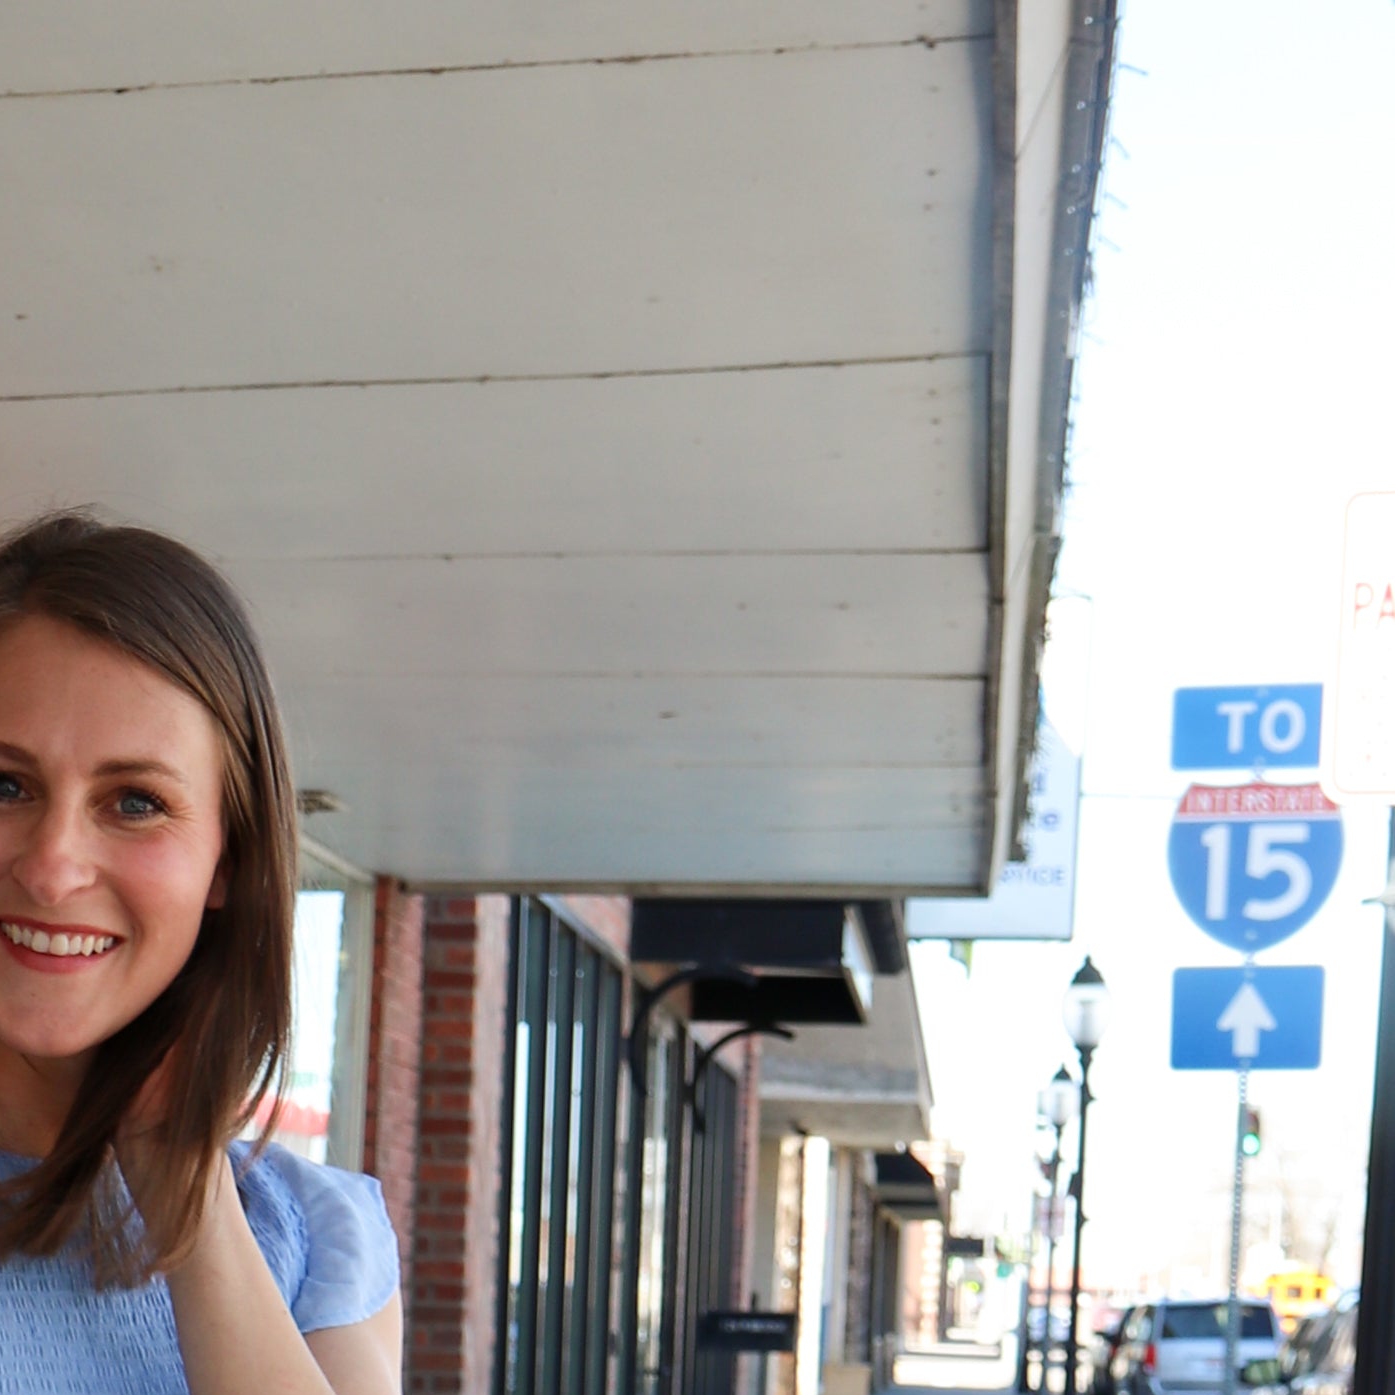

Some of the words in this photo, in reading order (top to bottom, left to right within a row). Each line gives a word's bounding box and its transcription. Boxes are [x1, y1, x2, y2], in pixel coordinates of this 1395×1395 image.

[1216, 698, 1306, 754] TO
[1185, 788, 1326, 814] INTERSTATE
[1200, 821, 1313, 922] 15
